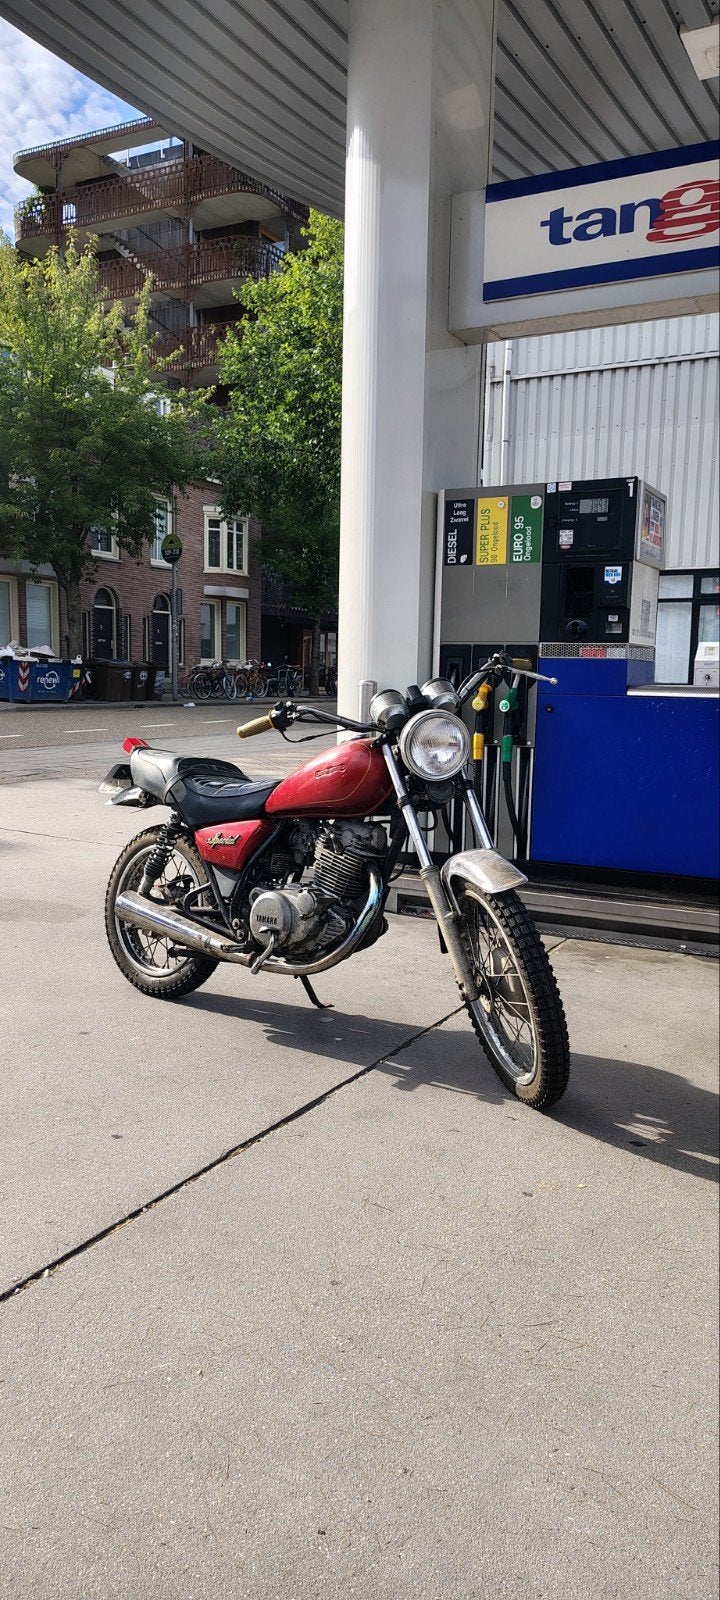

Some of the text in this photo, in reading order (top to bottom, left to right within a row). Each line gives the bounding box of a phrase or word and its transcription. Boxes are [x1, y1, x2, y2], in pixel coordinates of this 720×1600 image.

[627, 482, 634, 497] 1
[447, 528, 458, 564] DIESEL
[479, 508, 491, 563] SUPER PLUS
[490, 521, 500, 563] 98 Ongelood
[512, 515, 525, 562] EURO 95
[523, 526, 533, 561] Ongelood
[256, 914, 278, 924] YAMAHA
